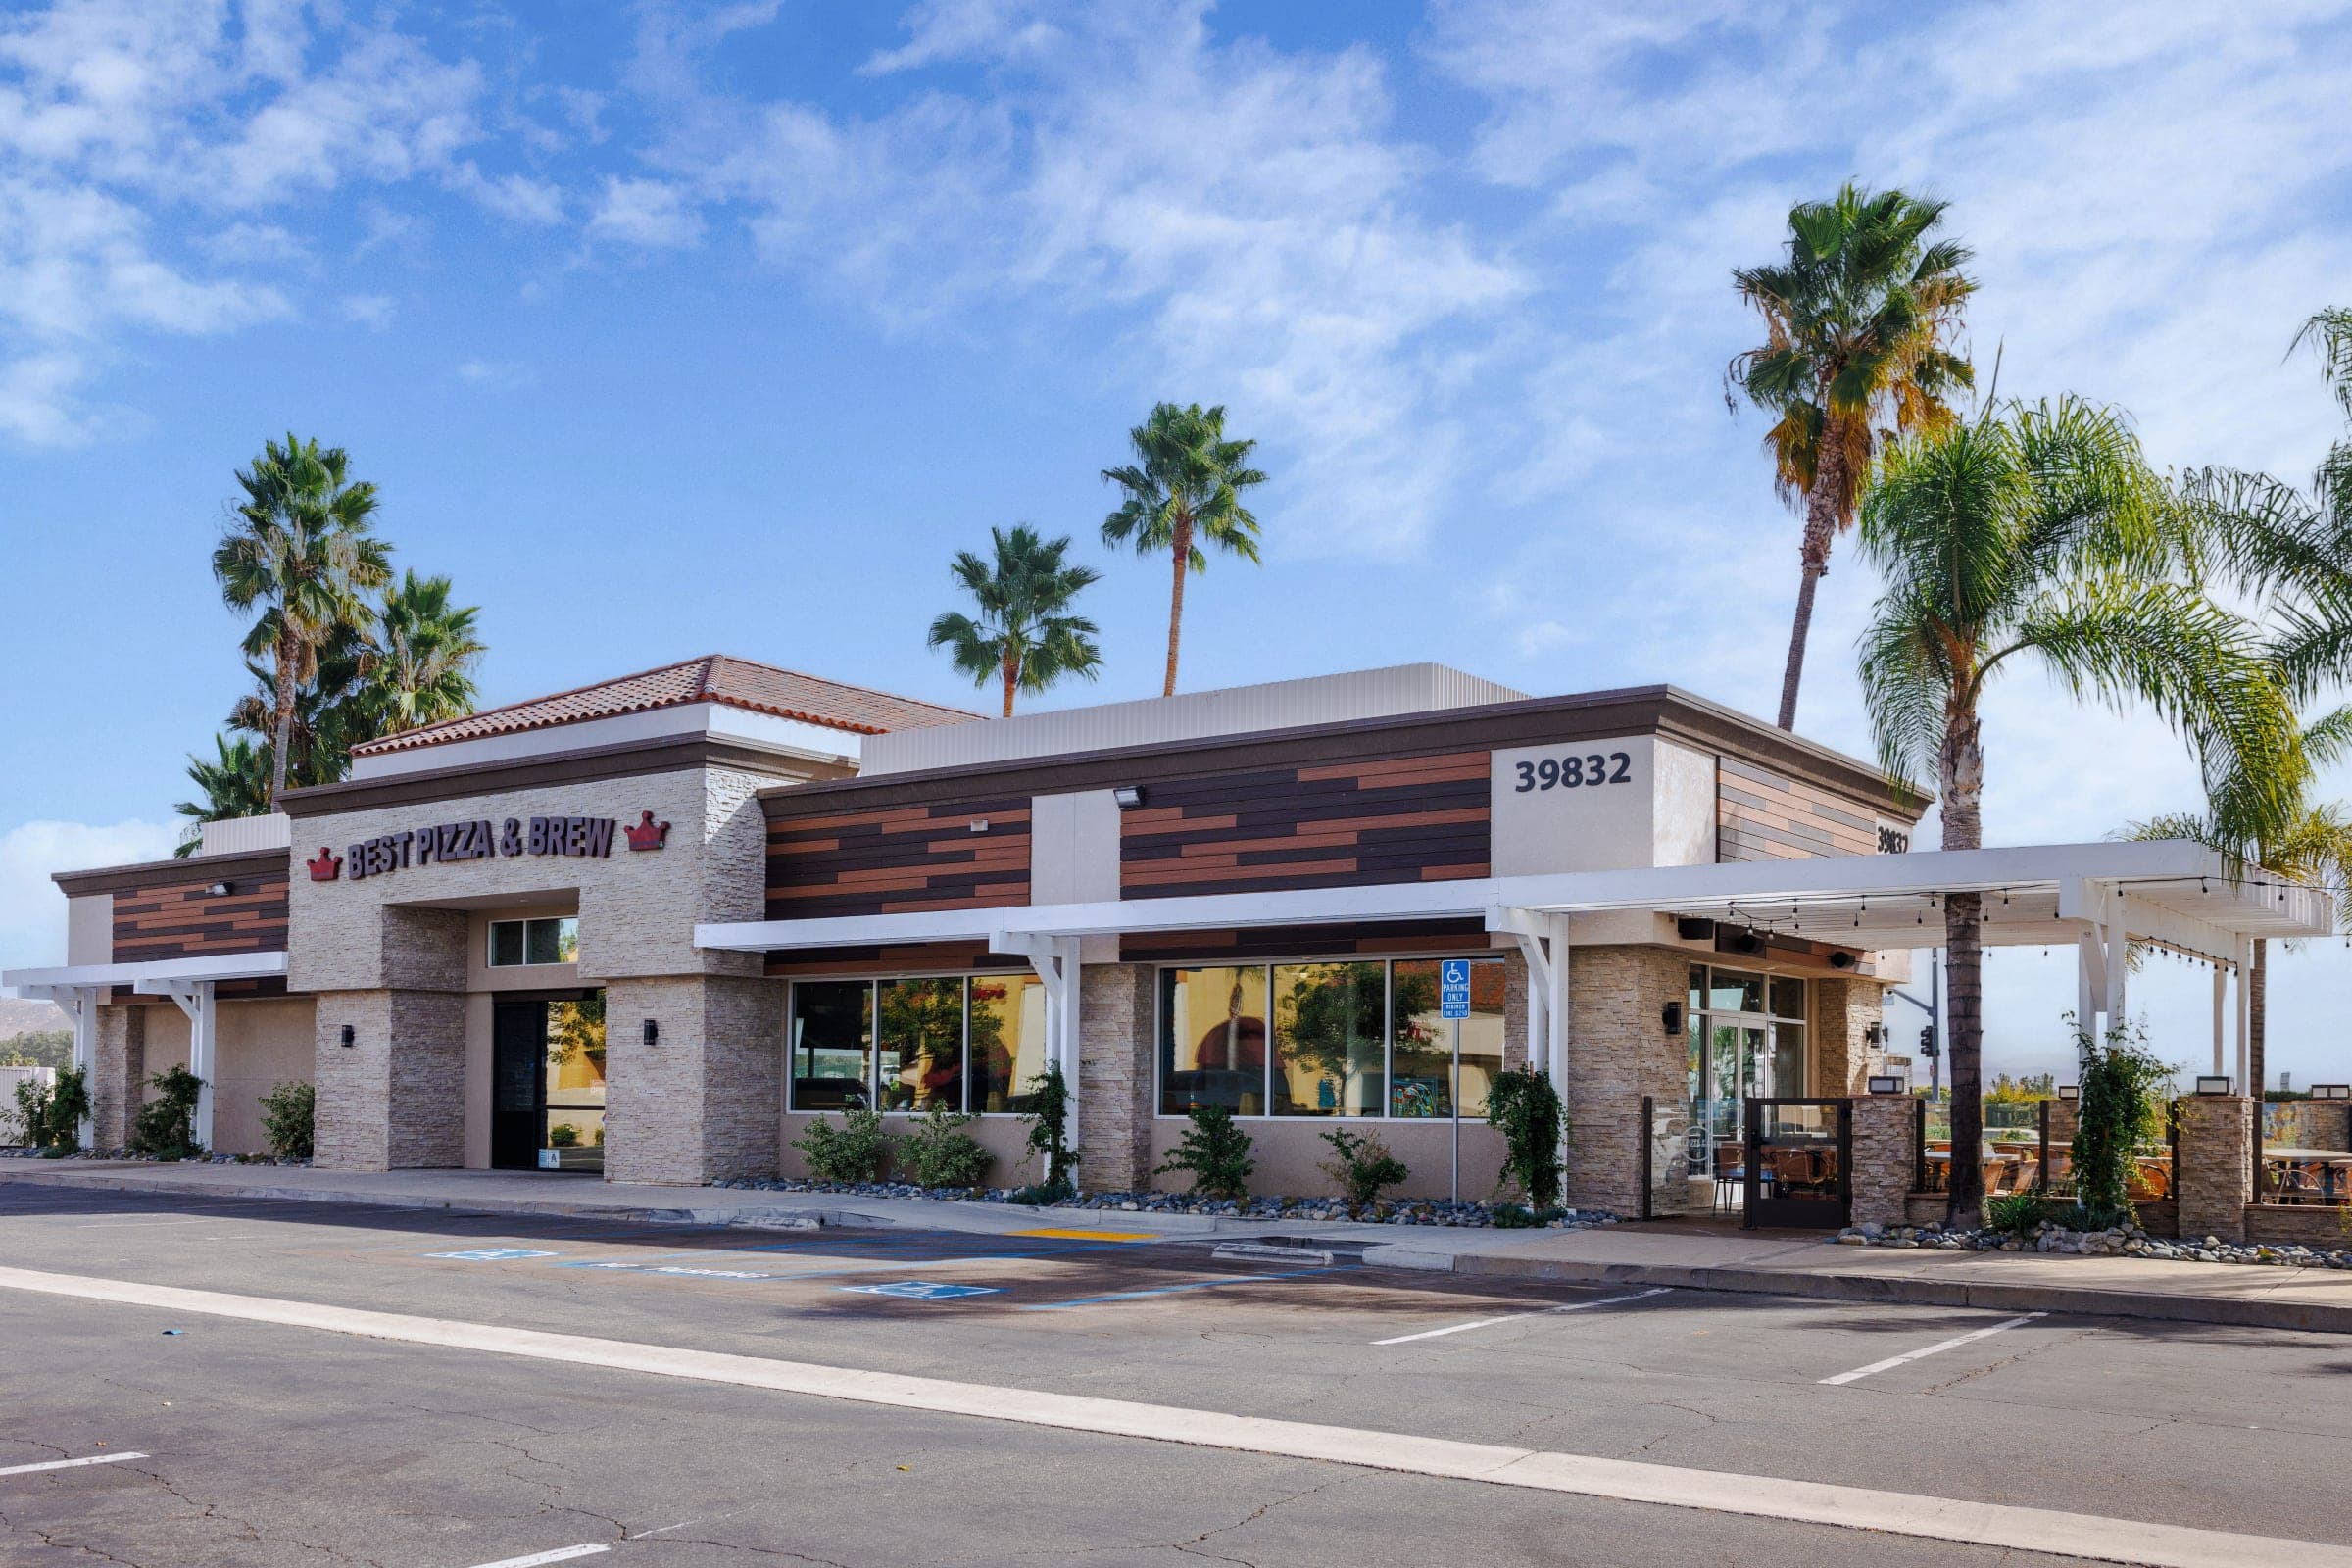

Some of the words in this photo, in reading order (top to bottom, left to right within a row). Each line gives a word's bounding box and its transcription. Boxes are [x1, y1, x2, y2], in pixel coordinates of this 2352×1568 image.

[1515, 752, 1631, 793] 39832
[348, 832, 414, 880] BEST
[416, 819, 495, 864] PIZZA
[500, 817, 522, 857] &
[528, 816, 615, 858] BREW
[1443, 983, 1469, 992] PARKING
[550, 1153, 558, 1163] A
